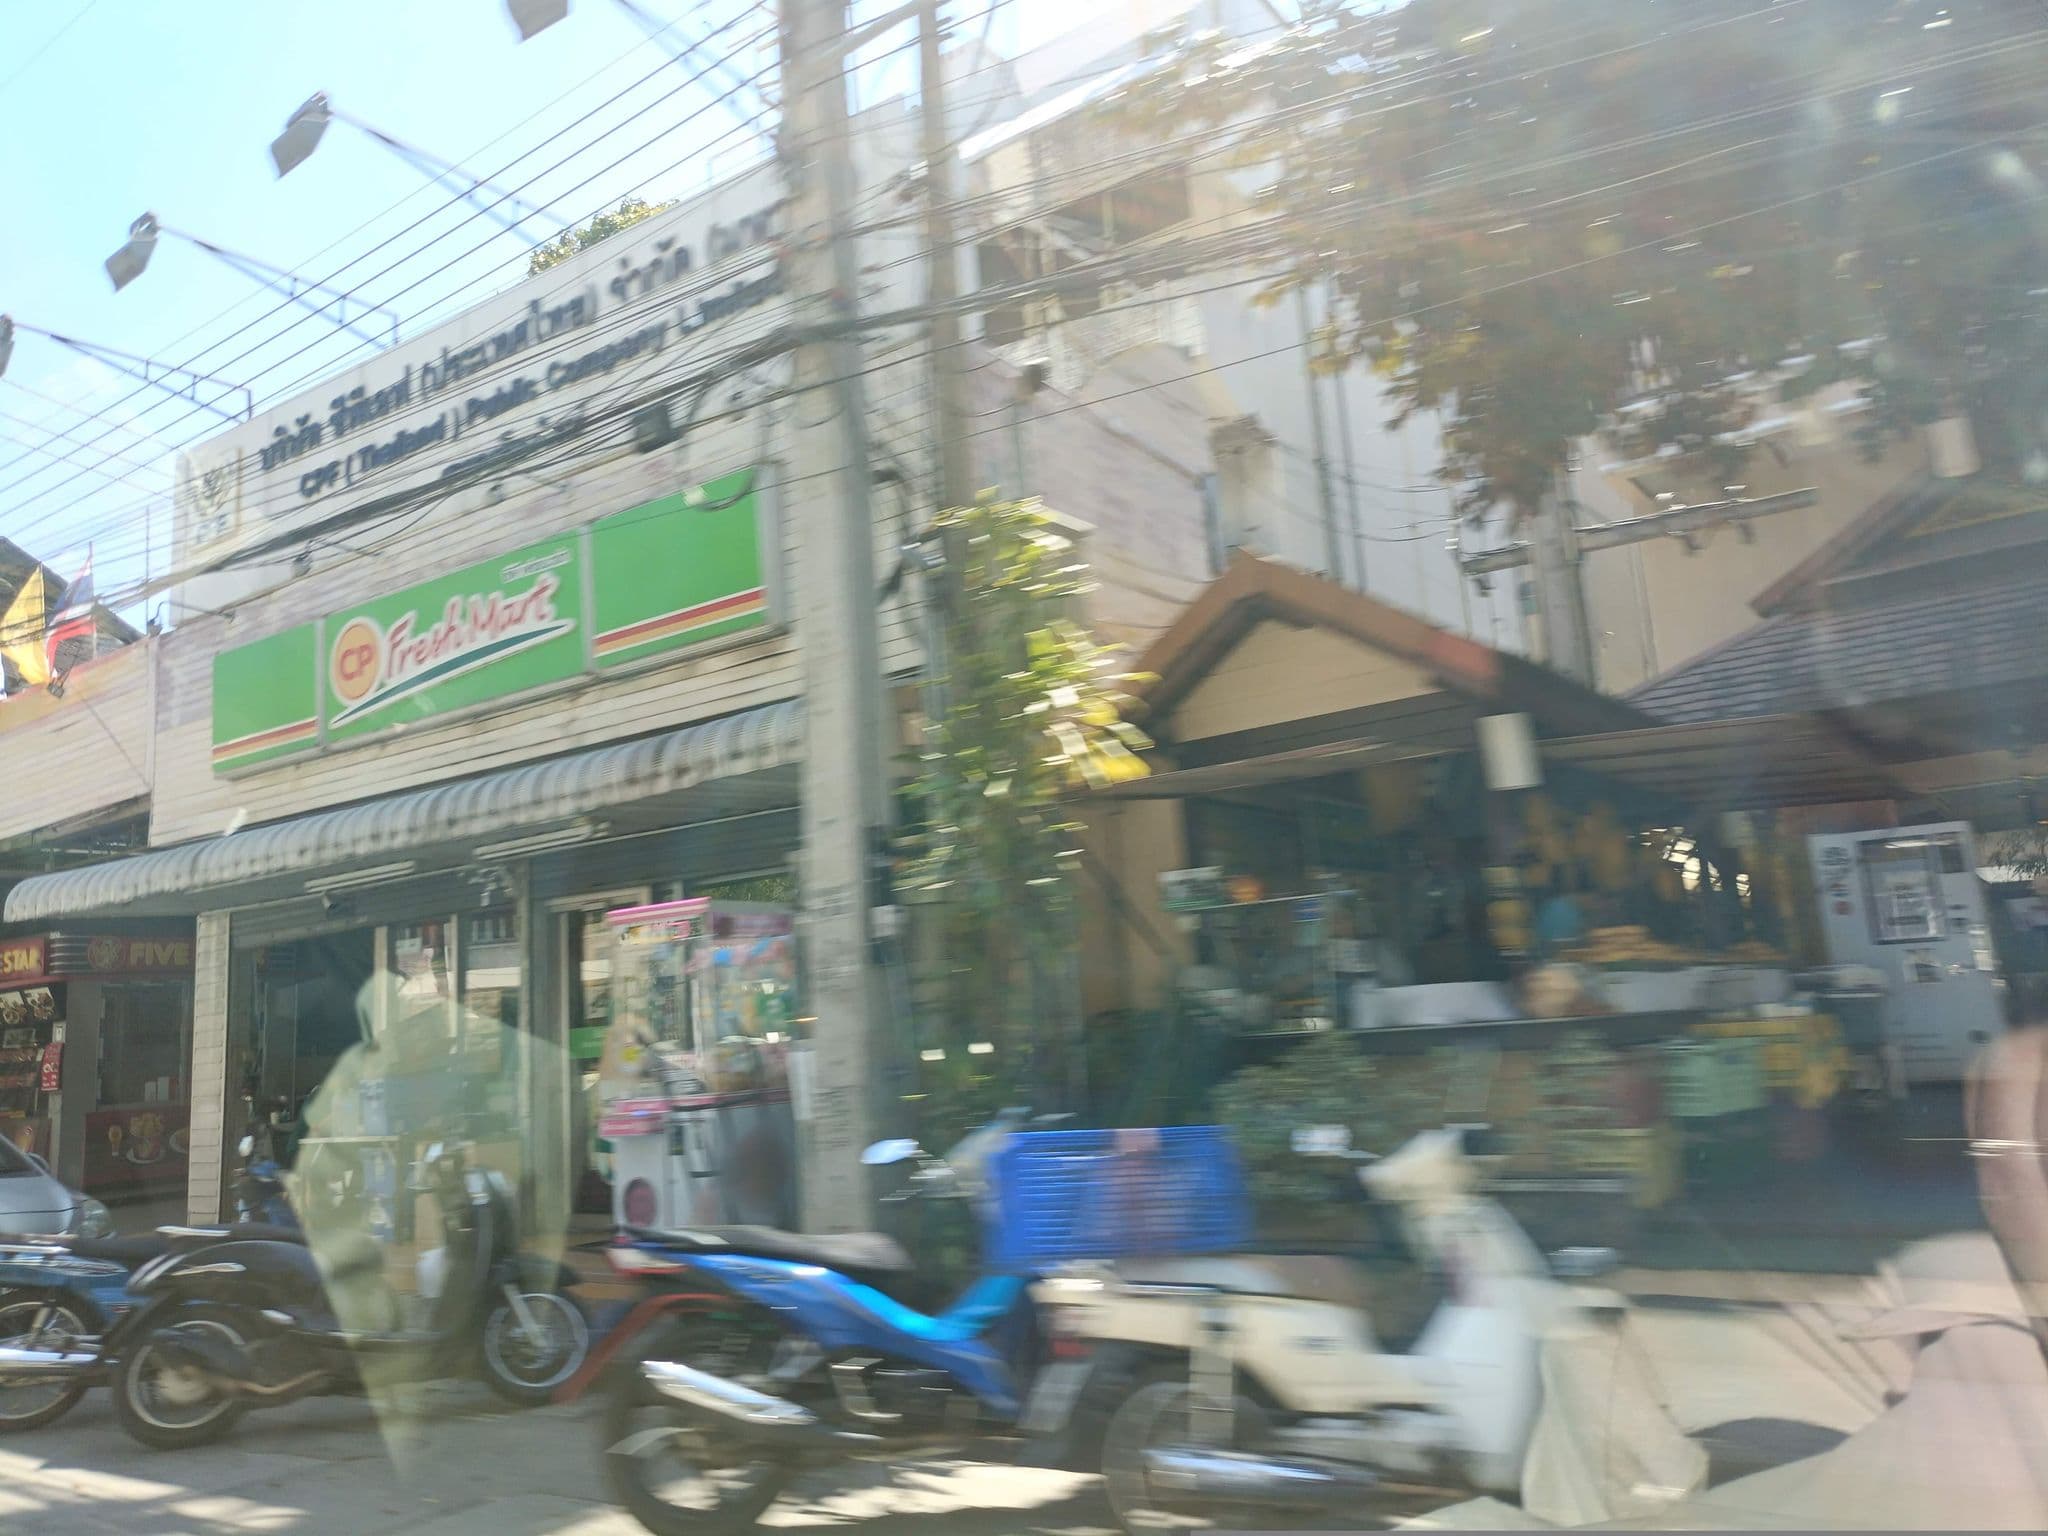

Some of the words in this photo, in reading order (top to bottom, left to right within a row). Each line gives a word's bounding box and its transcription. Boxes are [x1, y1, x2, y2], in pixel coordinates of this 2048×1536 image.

[300, 458, 341, 498] CPF
[466, 376, 538, 426] Public
[547, 319, 668, 392] Company
[339, 641, 375, 682] CP
[2, 946, 41, 976] STAR
[129, 942, 190, 967] FIVE
